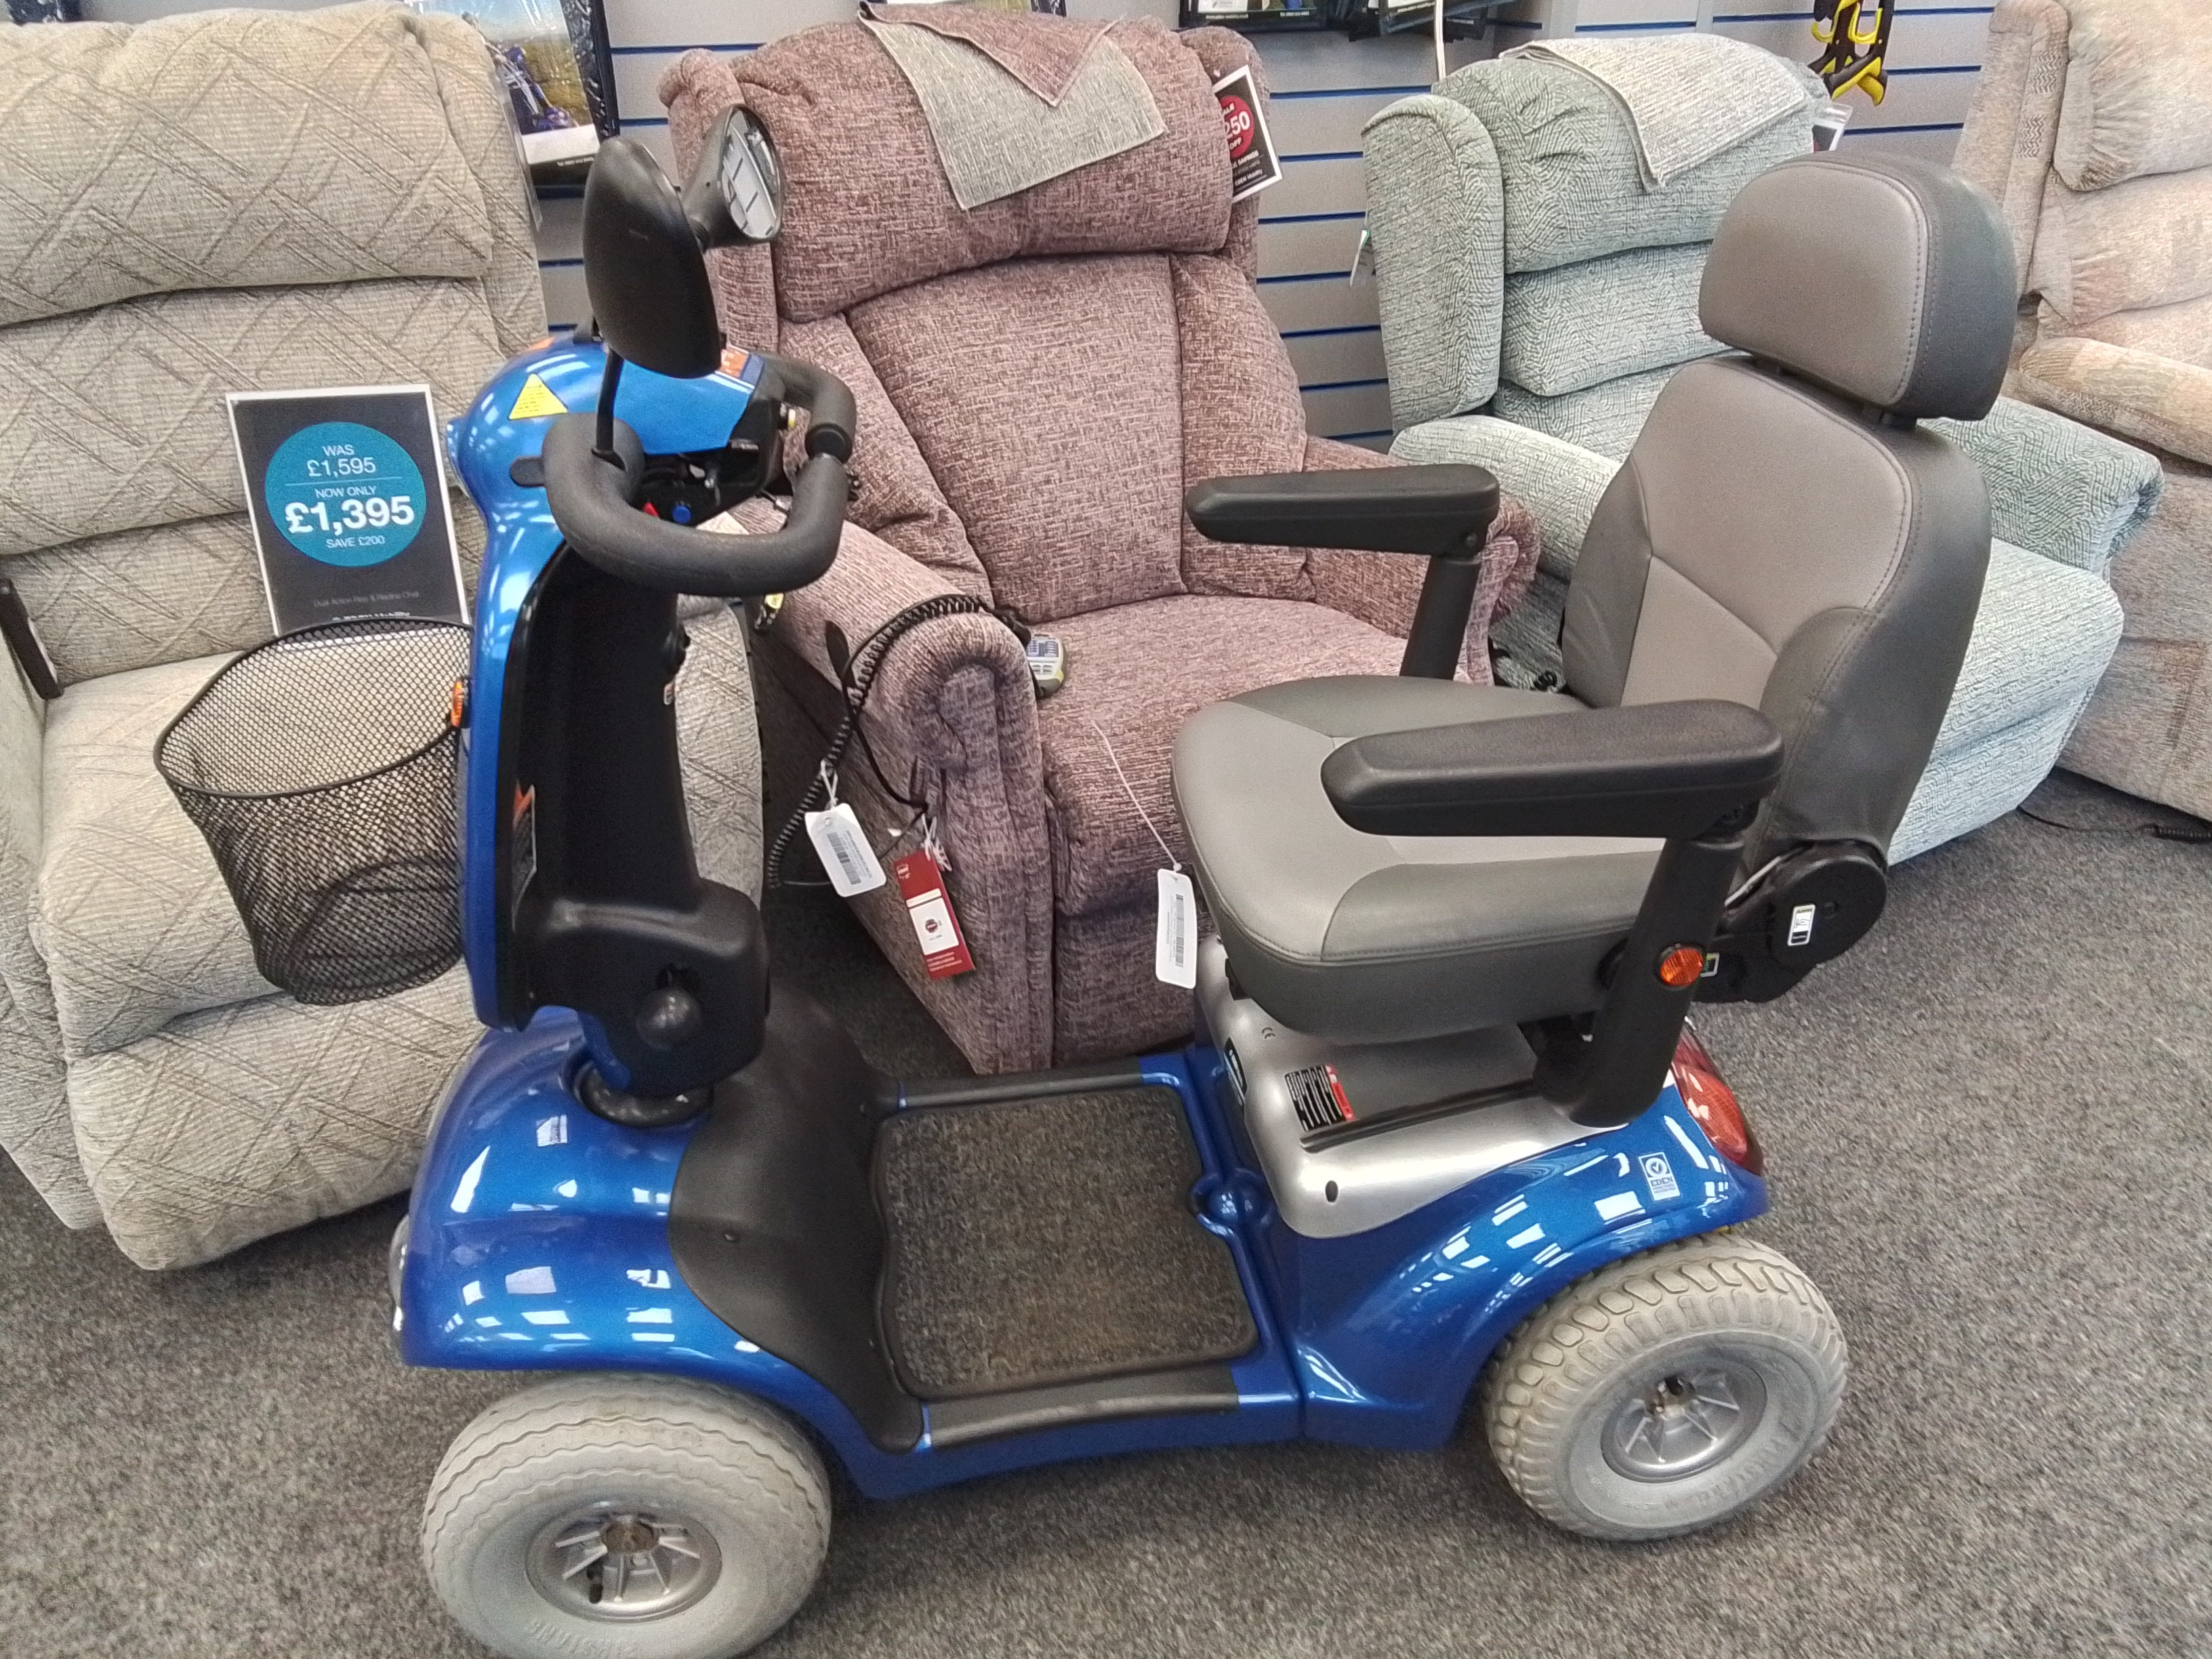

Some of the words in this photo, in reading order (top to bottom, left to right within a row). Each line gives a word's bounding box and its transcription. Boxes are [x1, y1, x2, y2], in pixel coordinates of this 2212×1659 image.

[323, 445, 354, 457] WAS
[306, 457, 376, 478] £1,595
[315, 487, 345, 497] NOW
[347, 486, 377, 496] ONLY
[285, 496, 414, 535] £1,395
[325, 537, 356, 549] SAVE
[357, 535, 386, 546] £200
[1650, 1176, 1673, 1187] EDEN
